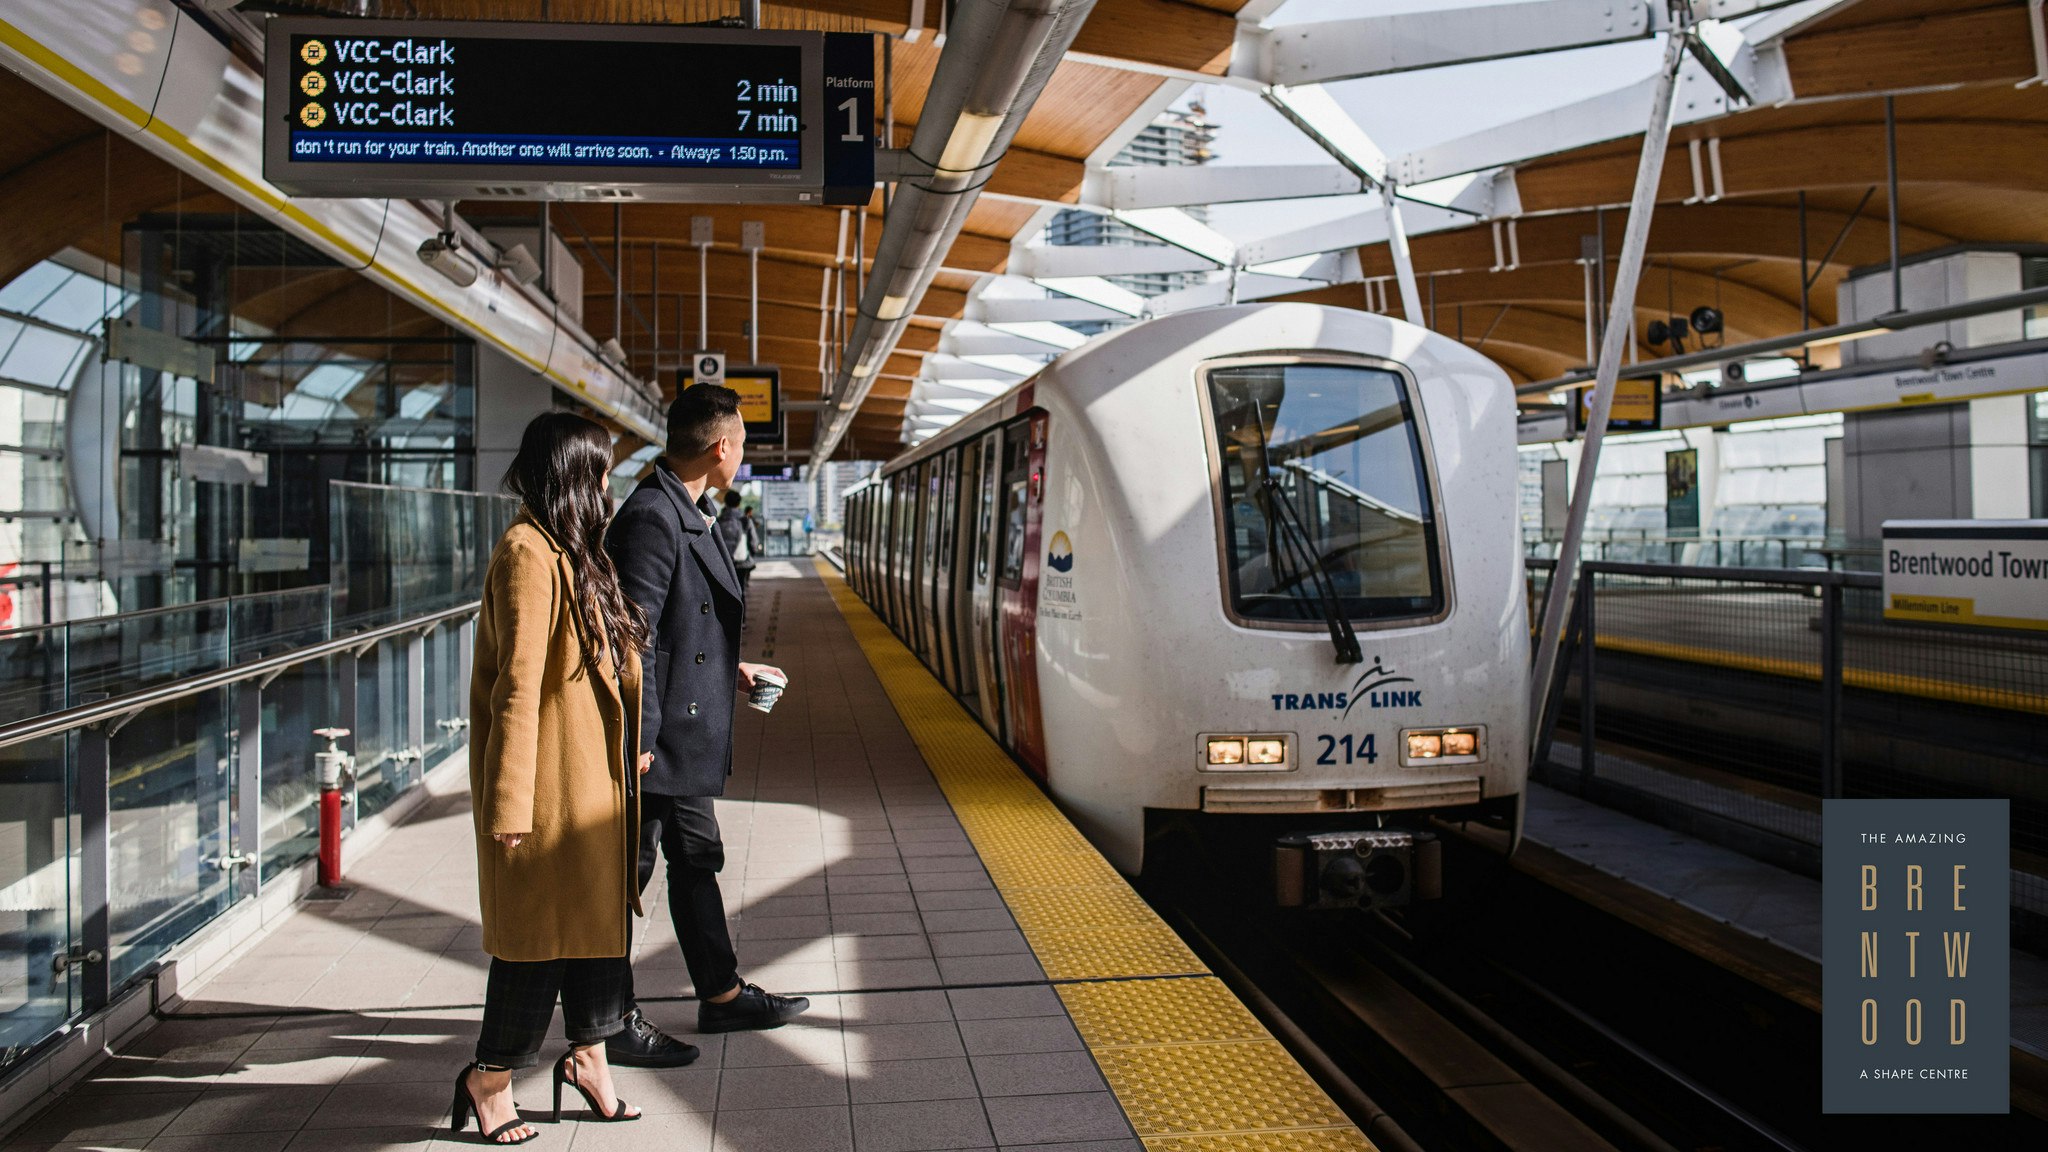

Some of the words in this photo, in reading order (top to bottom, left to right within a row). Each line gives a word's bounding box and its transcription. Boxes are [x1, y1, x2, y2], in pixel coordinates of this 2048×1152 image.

[334, 39, 455, 64] VCC-Clark
[334, 70, 455, 95] VCC-Clark
[737, 80, 751, 101] 2
[757, 78, 798, 102] min
[826, 76, 874, 88] Platform
[333, 101, 455, 126] VCC-Clark
[737, 110, 751, 131] 7
[757, 108, 798, 132] min
[838, 97, 864, 142] 1
[337, 142, 361, 155] run
[364, 140, 385, 155] for
[388, 142, 420, 159] your
[423, 141, 459, 156] train.
[461, 141, 516, 157] Another
[518, 144, 544, 157] one
[547, 143, 572, 157] will
[574, 143, 615, 158] arrive
[617, 146, 652, 159] soon.
[671, 145, 721, 163] Always
[759, 148, 789, 164] p.m.
[1889, 550, 1993, 577] Brentwood
[1046, 574, 1073, 588] BRITISH
[1893, 599, 1939, 613] Millennium
[1940, 602, 1959, 615] Line
[1316, 733, 1378, 765] 214
